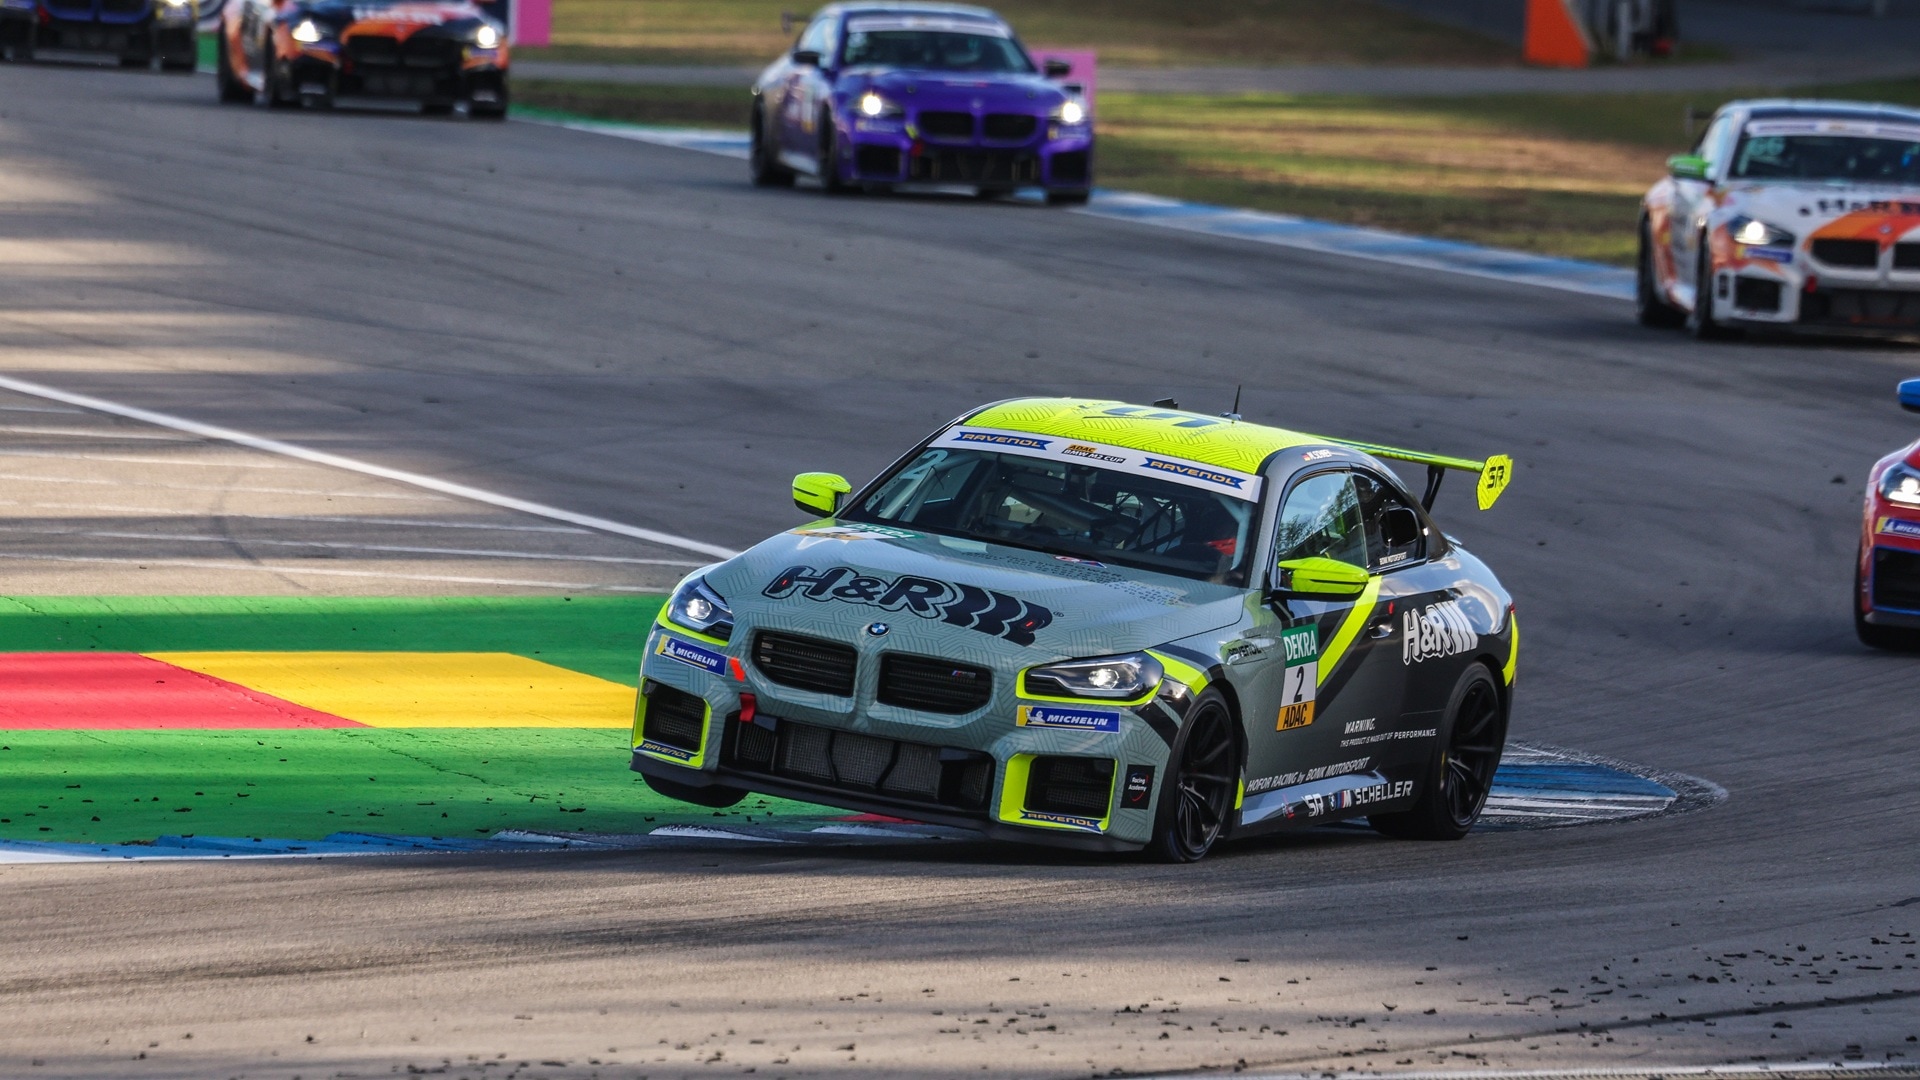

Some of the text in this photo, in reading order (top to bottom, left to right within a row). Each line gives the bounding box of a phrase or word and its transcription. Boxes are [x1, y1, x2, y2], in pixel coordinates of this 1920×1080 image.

[962, 433, 1041, 447] RAVENOL
[1068, 444, 1096, 453] ADAC
[1064, 449, 1089, 457] BMW
[899, 449, 948, 480] 2
[1150, 460, 1236, 486] RAVENOL
[1487, 465, 1504, 489] SR
[1283, 630, 1317, 661] DEKRA
[675, 647, 718, 667] MICHELIN
[1293, 666, 1304, 703] 2
[1047, 714, 1108, 726] MICHELIN
[1283, 703, 1307, 729] ADAC
[643, 743, 688, 759] RAVENOL
[1349, 736, 1367, 746] PRODUCT
[1246, 756, 1371, 793] HOFOR RACING by BONK MOTORSPORT
[1354, 780, 1413, 805] SCHELLER
[1027, 813, 1095, 827] RAVENOL
